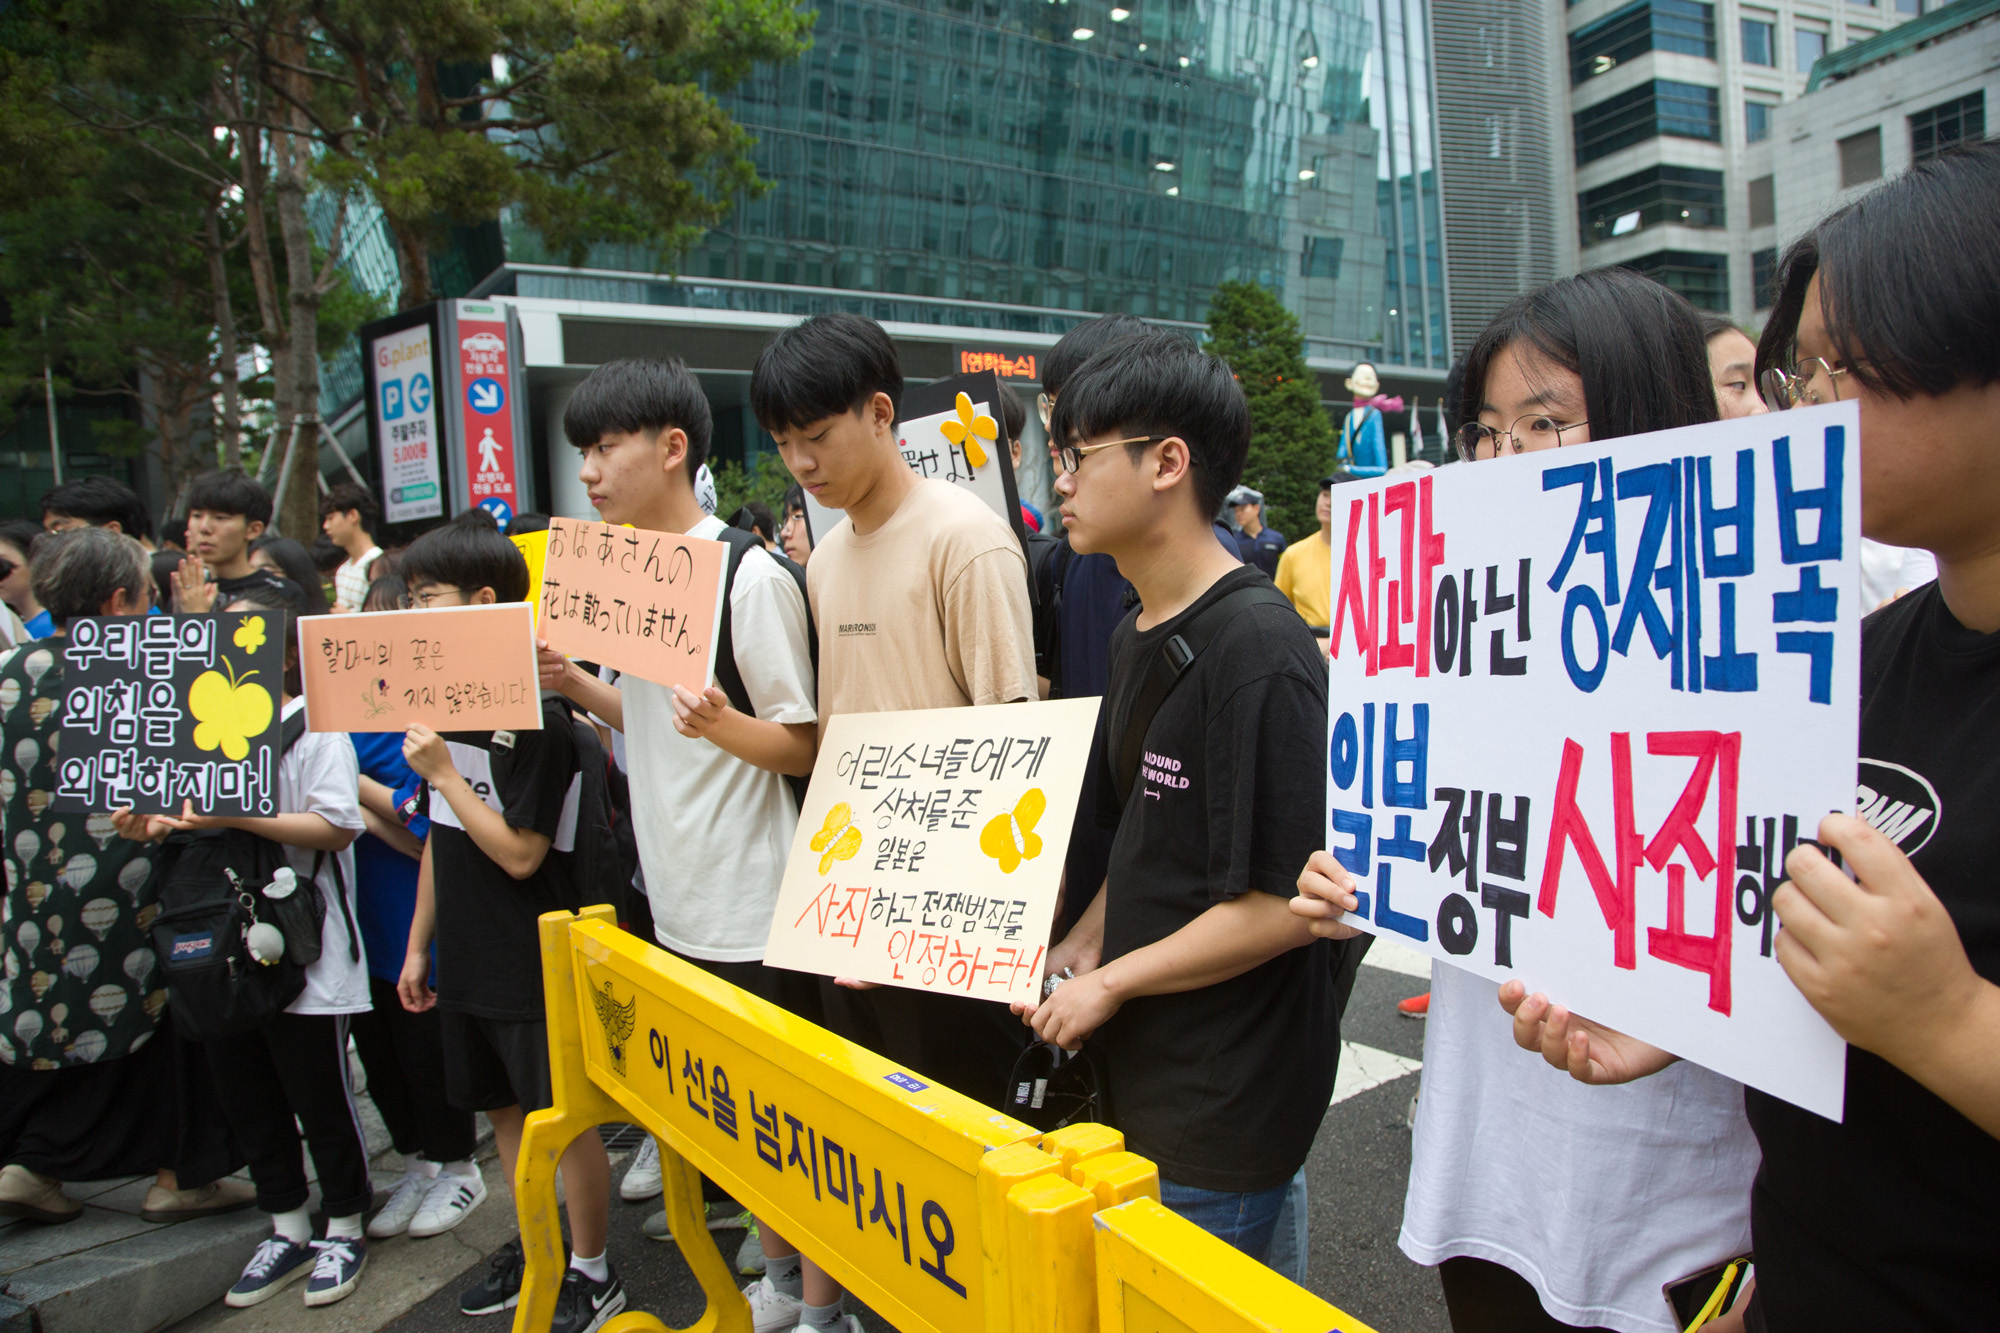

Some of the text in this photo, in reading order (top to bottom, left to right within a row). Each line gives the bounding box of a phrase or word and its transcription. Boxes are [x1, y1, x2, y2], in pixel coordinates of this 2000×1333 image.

[378, 338, 429, 371] G.plant
[550, 520, 693, 591] おばあさんの
[1330, 424, 1845, 705] 사과 아닌 경제보복
[65, 618, 216, 678] 우리들의
[543, 577, 701, 655] 花は散っていません。
[321, 638, 444, 674] 할머니의 꽃은
[63, 679, 182, 746] 외침을
[404, 678, 527, 714] 지지 않았습니다
[57, 745, 272, 814] 외면하지마!
[1148, 769, 1190, 789] WORLD
[873, 836, 926, 872] 일본은
[1428, 786, 1530, 968] 정부
[887, 929, 1045, 992] 인정하라!
[649, 1028, 968, 1300] 이 선을 넘지마시오
